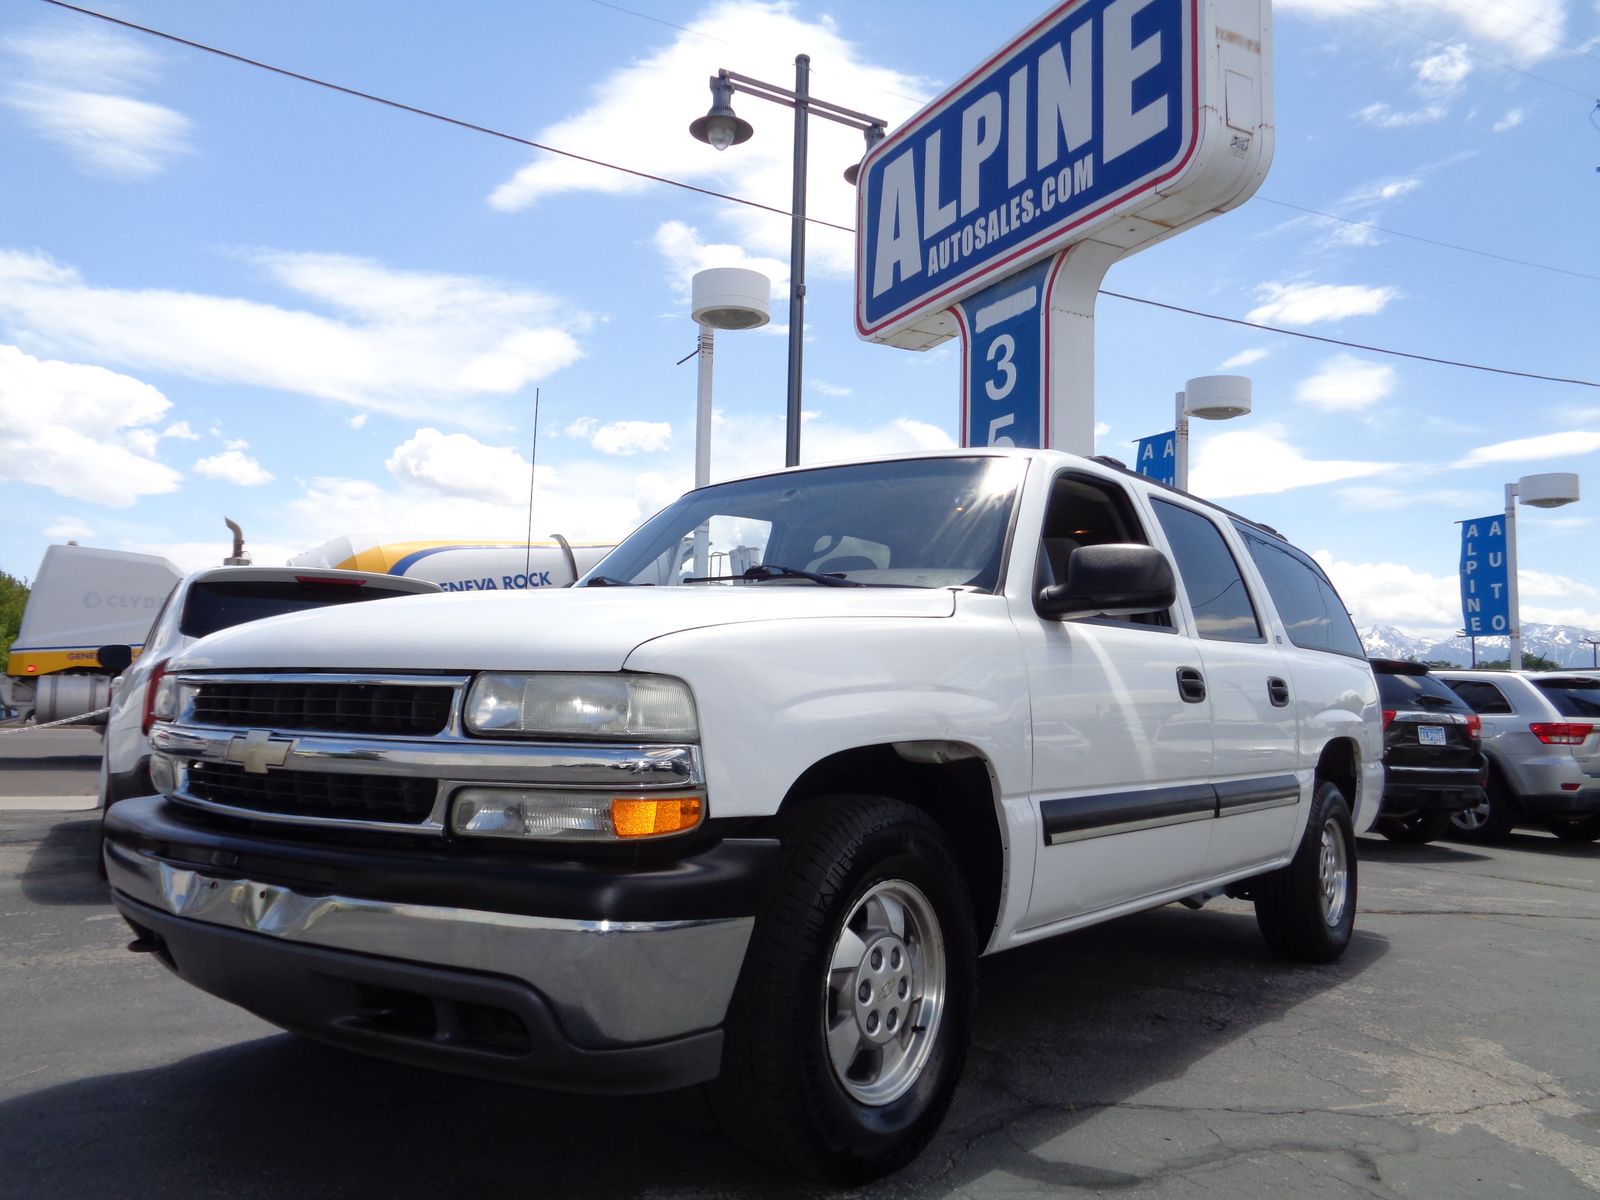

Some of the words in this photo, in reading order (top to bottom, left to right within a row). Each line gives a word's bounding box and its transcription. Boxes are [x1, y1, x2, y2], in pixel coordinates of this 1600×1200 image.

[872, 0, 1169, 299] ALPINE
[927, 152, 1094, 278] AUTOSALES.COM
[106, 594, 157, 609] CLYD
[440, 577, 498, 592] ENEVA
[502, 571, 552, 589] ROCK
[1466, 524, 1481, 631] ALPINE
[1488, 521, 1505, 631] AUTO
[68, 652, 96, 660] GENE
